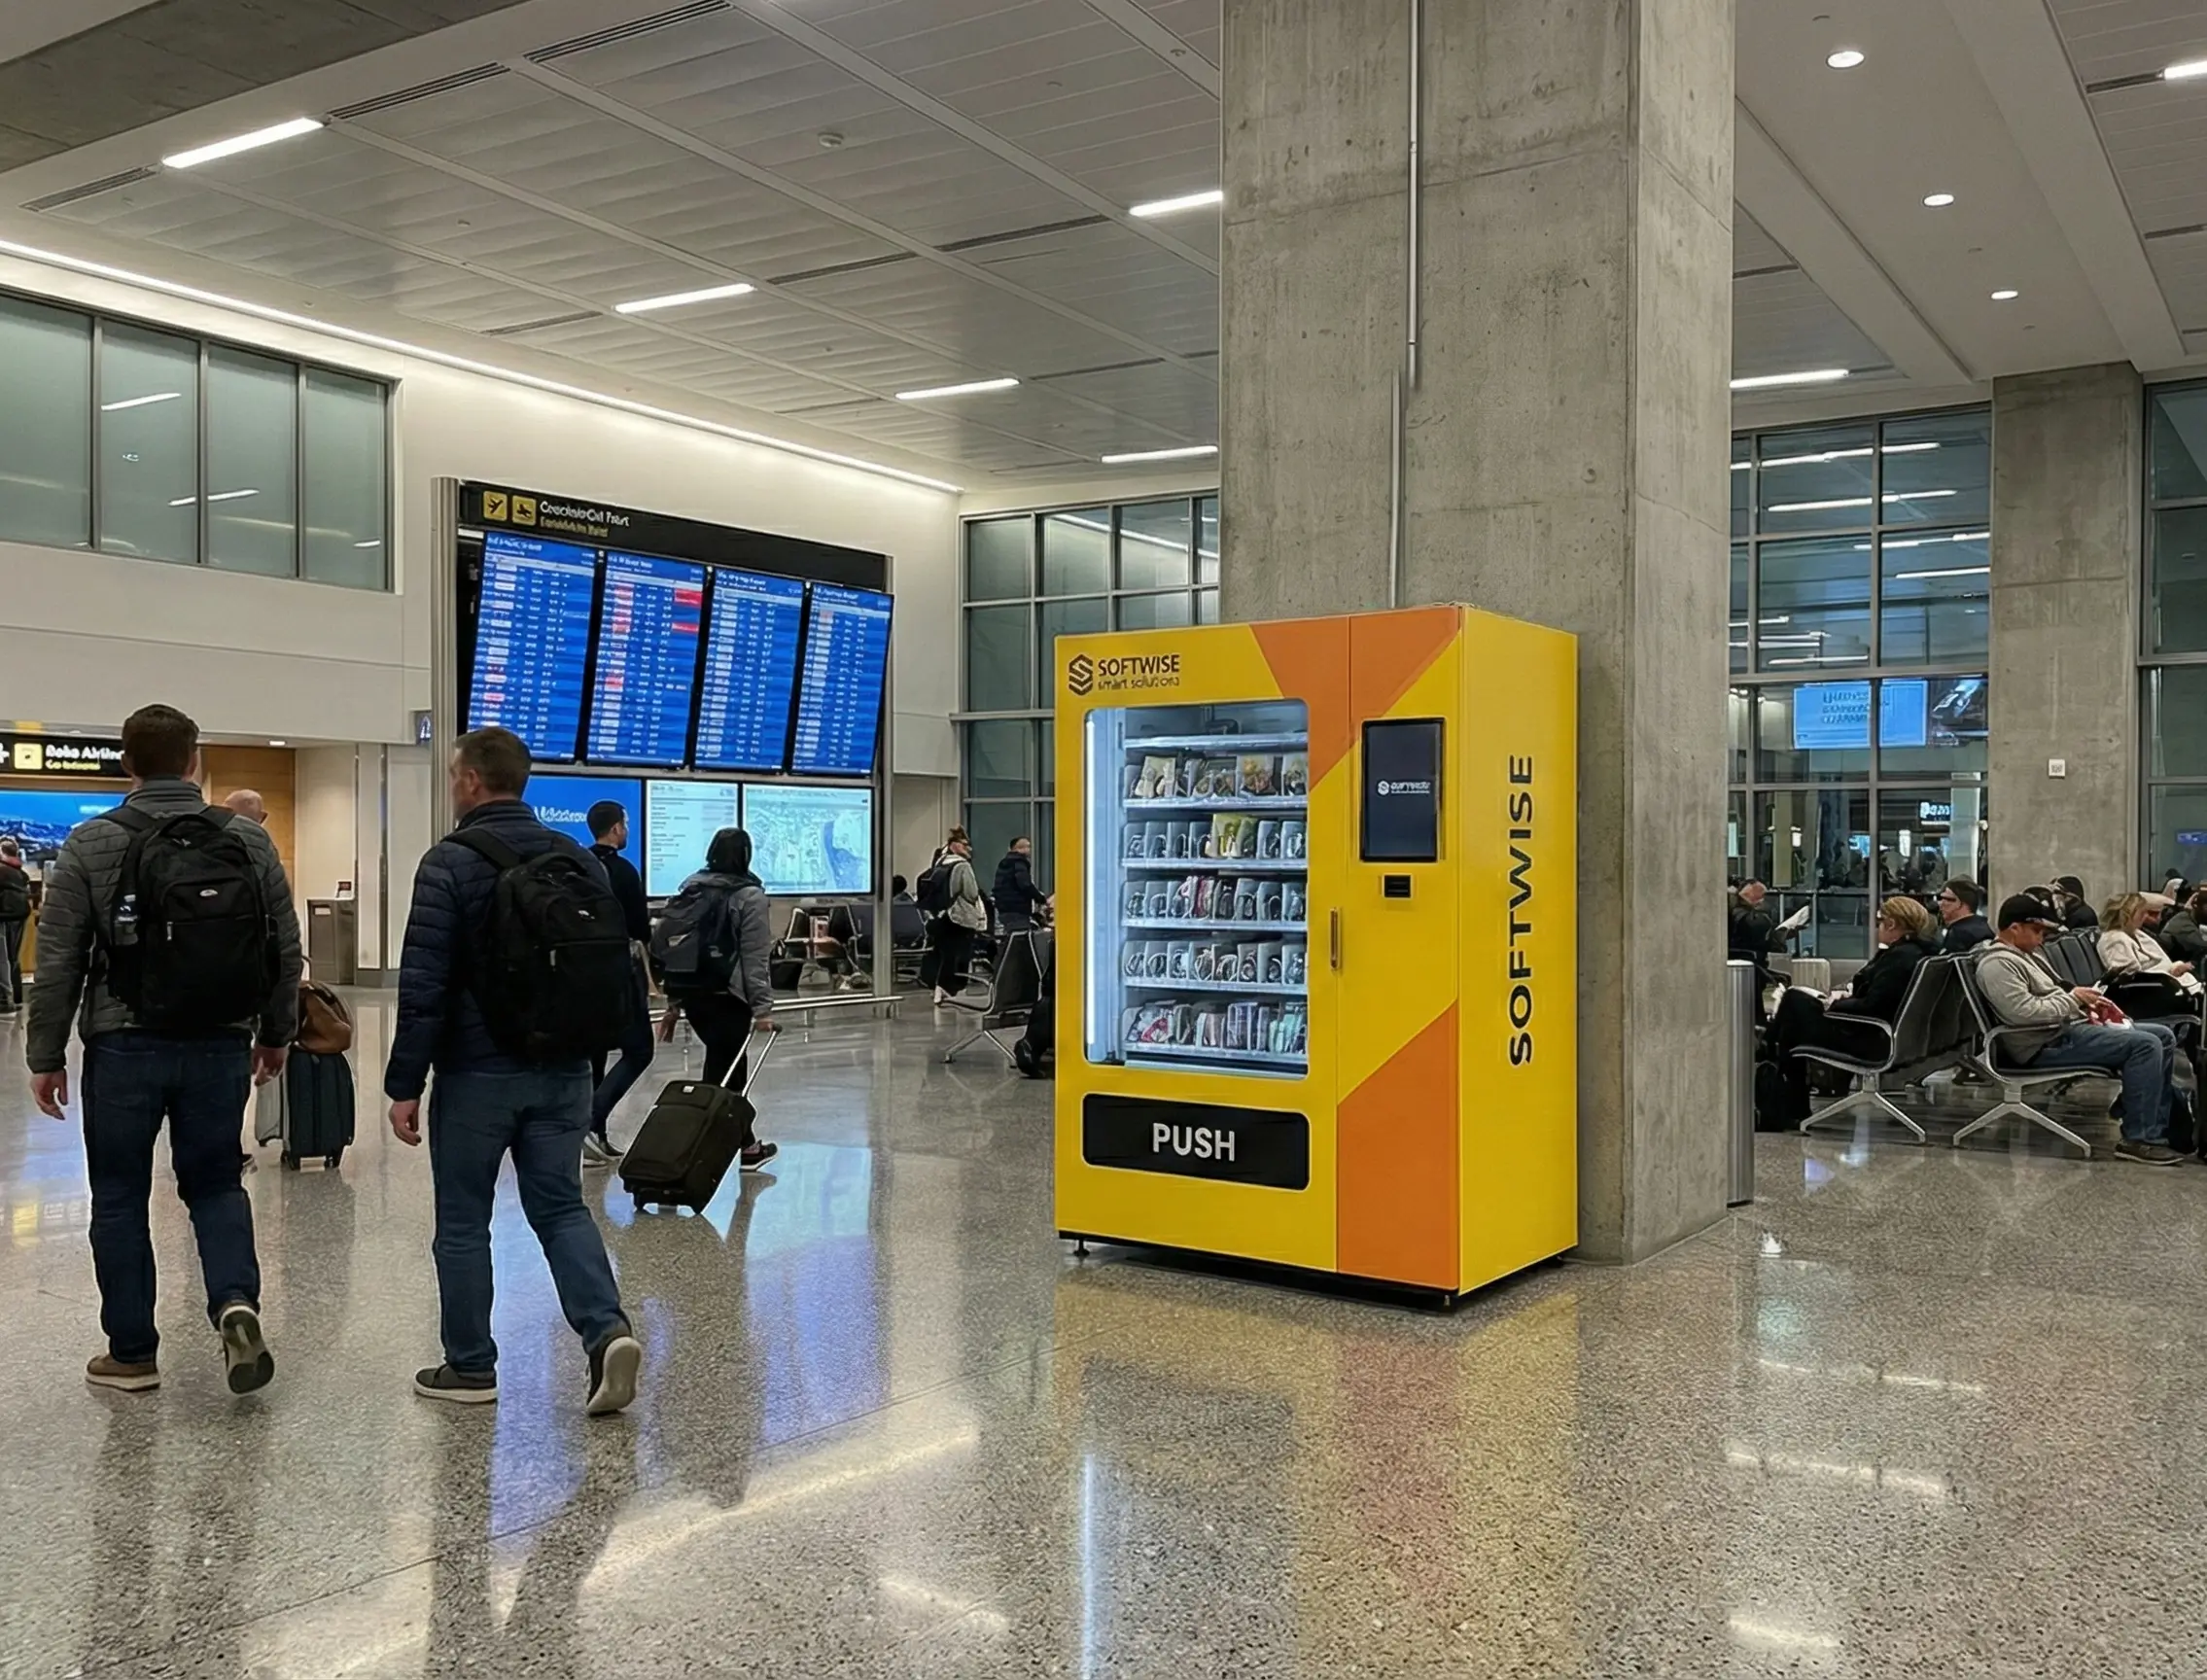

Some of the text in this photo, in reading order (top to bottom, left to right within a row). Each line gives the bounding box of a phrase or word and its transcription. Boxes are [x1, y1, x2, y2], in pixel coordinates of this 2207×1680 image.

[1098, 654, 1180, 677] SOFTWISE
[1509, 754, 1532, 1067] SOFTWISE
[1152, 1122, 1235, 1162] PUSH
